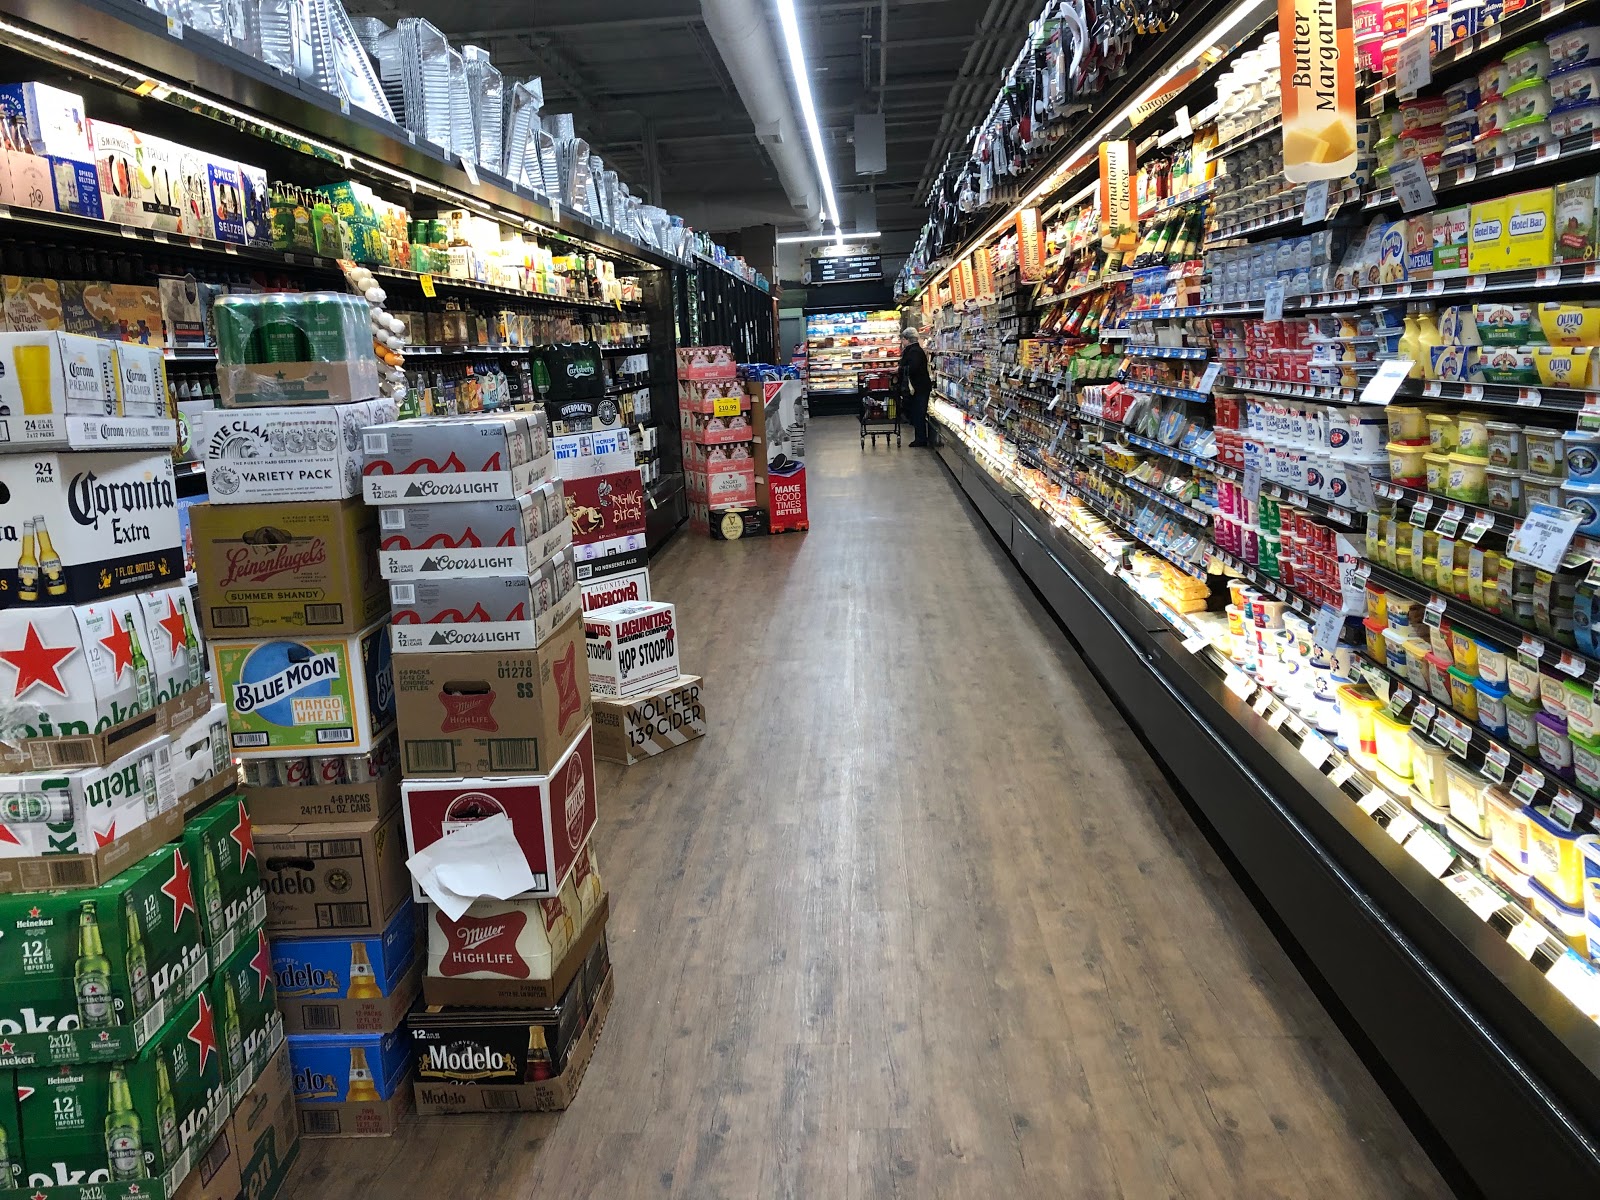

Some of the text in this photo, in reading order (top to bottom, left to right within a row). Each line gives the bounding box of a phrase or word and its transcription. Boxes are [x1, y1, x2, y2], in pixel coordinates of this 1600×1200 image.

[1291, 9, 1312, 89] Butter
[1107, 151, 1118, 231] International
[1119, 169, 1130, 211] Cheese
[218, 221, 244, 236] SELTZER
[1452, 221, 1466, 233] LAKES
[1474, 225, 1499, 237] Hotel Bar
[1511, 217, 1543, 231] Hotel Bar
[861, 245, 868, 255] 6
[1031, 243, 1039, 266] Chunk
[1408, 253, 1432, 268] IMPERIAL
[8, 312, 42, 325] Namaste
[66, 317, 96, 331] Indian
[1556, 313, 1583, 326] OLIVIO
[1488, 331, 1517, 339] MARGARINE
[69, 360, 95, 379] Corona
[566, 363, 595, 379] Carlsberg
[1549, 358, 1572, 371] OLIVIO
[126, 369, 147, 384] Corona
[69, 379, 99, 393] PREMIER
[126, 384, 152, 396] PREMIER
[561, 403, 592, 415] OVERPACK'D
[718, 404, 737, 412] $10.99
[24, 420, 37, 431] 24
[83, 422, 90, 432] 24
[101, 423, 125, 440] Corona
[125, 428, 150, 437] PREMIER
[209, 421, 269, 459] HITE CLAW
[35, 462, 53, 476] 24
[220, 465, 236, 475] CLAW
[242, 469, 333, 482] VARIETY PACK
[371, 483, 382, 491] 2x
[420, 480, 499, 496] Coors LIGHT
[774, 484, 800, 494] MAKE
[68, 470, 174, 531] Coronita
[609, 489, 643, 509] RAGING
[775, 492, 801, 502] GOOD
[776, 501, 802, 509] TIMES
[776, 508, 802, 516] BETTER
[612, 507, 641, 523] BITCH
[111, 518, 151, 545] Extra
[135, 561, 156, 575] BOTTLES
[220, 538, 327, 587] Leinenkugel's
[435, 556, 513, 570] Coors LIGHT
[602, 560, 625, 571] NONSENSE
[626, 557, 637, 565] ALES
[590, 578, 630, 592] LAGUNITAS
[230, 591, 319, 601] SUMMER SHANDY
[616, 610, 672, 638] LAGUNITAS
[150, 627, 160, 642] 12
[443, 629, 521, 645] Coors LIGHT
[617, 623, 674, 645] BREWING COMPANY
[88, 647, 101, 663] 12
[586, 643, 612, 661] STOOPID
[618, 638, 674, 671] HOP STOOPID
[497, 667, 533, 679] 01278
[235, 656, 337, 712] BLUE MOON
[517, 682, 534, 699] SS
[294, 698, 341, 711] MANGO
[627, 686, 699, 726] WÖLFFER
[295, 709, 341, 723] WHEAT
[450, 716, 470, 724] HIGH
[604, 719, 620, 727] CIDER
[628, 707, 701, 748] 139 CIDER
[345, 794, 370, 803] PACKS
[300, 804, 371, 815] 24/12 FL. OZ. CANS
[217, 836, 227, 854] 12
[261, 871, 316, 895] odelo
[143, 894, 156, 915] 12
[16, 918, 54, 929] Heineken
[457, 925, 505, 950] Miller
[21, 940, 44, 958] 12
[23, 956, 44, 965] PACK
[453, 952, 514, 964] HIGH LIFE
[24, 963, 54, 971] IMPORTED
[274, 963, 326, 988] odelo
[48, 1034, 71, 1049] 2x12
[412, 1030, 426, 1039] 12
[90, 1041, 120, 1049] Heineken
[171, 1043, 183, 1066] 12
[428, 1044, 504, 1070] Modelo
[47, 1075, 84, 1085] Heineken
[421, 1089, 466, 1105] Modelo
[52, 1096, 75, 1113] 12
[54, 1112, 75, 1120] PACK
[55, 1119, 85, 1127] IMPORTED
[80, 1186, 102, 1200] 2x12
